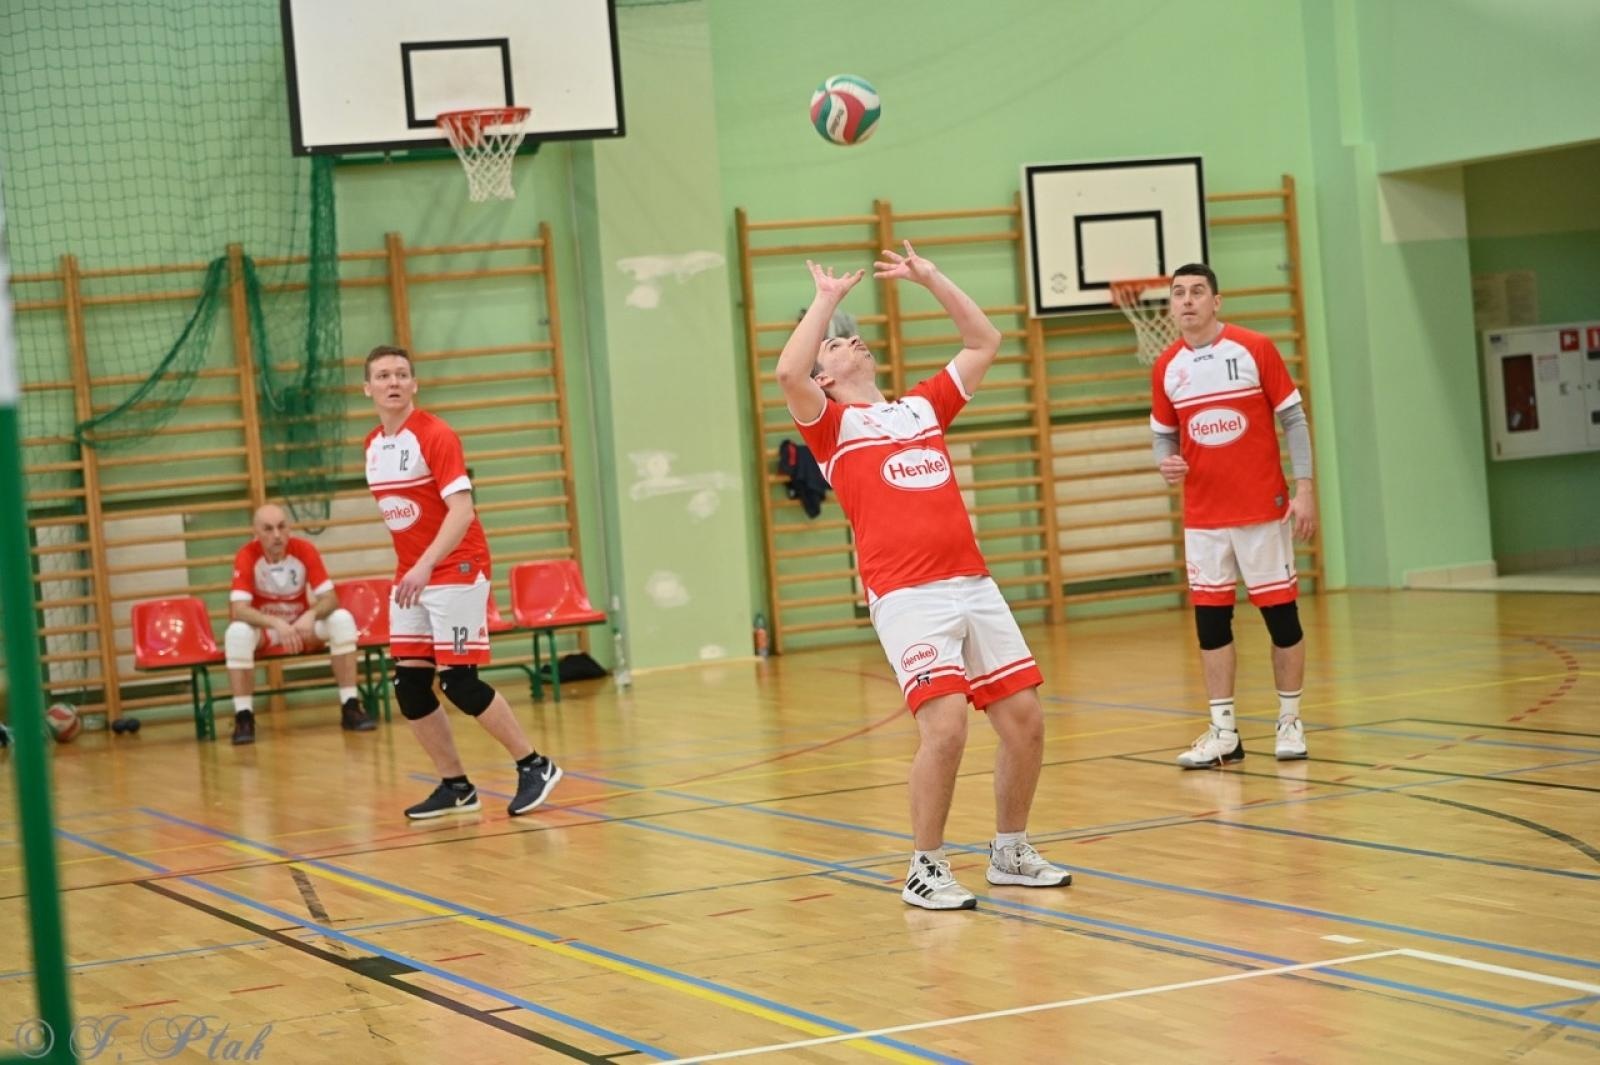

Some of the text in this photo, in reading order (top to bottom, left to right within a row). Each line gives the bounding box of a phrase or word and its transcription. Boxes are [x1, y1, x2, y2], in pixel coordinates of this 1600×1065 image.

[1225, 357, 1239, 381] 11
[1190, 415, 1242, 437] Henkel
[399, 449, 410, 471] 12
[888, 456, 947, 480] Henkel
[383, 503, 416, 520] enkel
[452, 625, 469, 654] 12
[903, 647, 935, 668] Henkel
